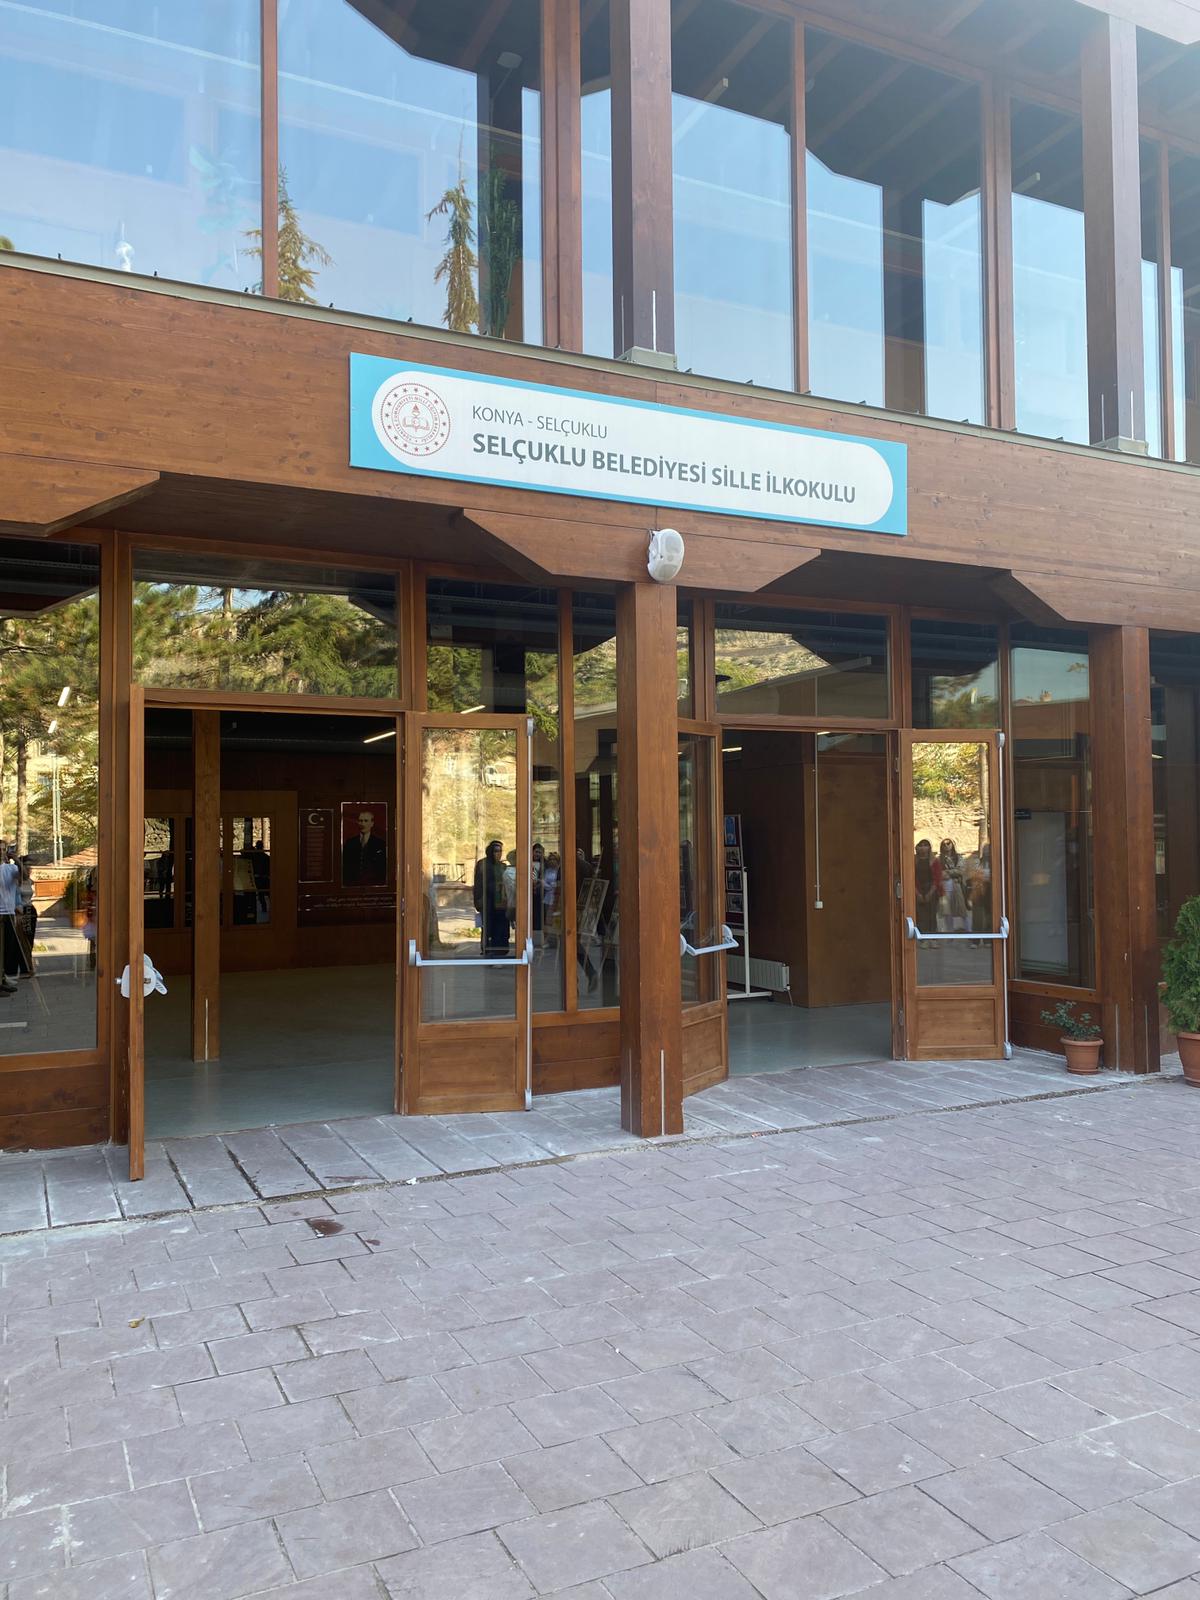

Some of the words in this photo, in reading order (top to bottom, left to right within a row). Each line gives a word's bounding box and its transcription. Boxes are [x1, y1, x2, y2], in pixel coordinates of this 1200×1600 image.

[472, 405, 524, 426] KONYA
[536, 415, 608, 439] SELÇUKLU
[473, 433, 586, 467] SELÇUKLU
[592, 450, 706, 484] BELEDİYESİ
[712, 465, 761, 491] SİLLE
[766, 470, 856, 504] İLKOKULU
